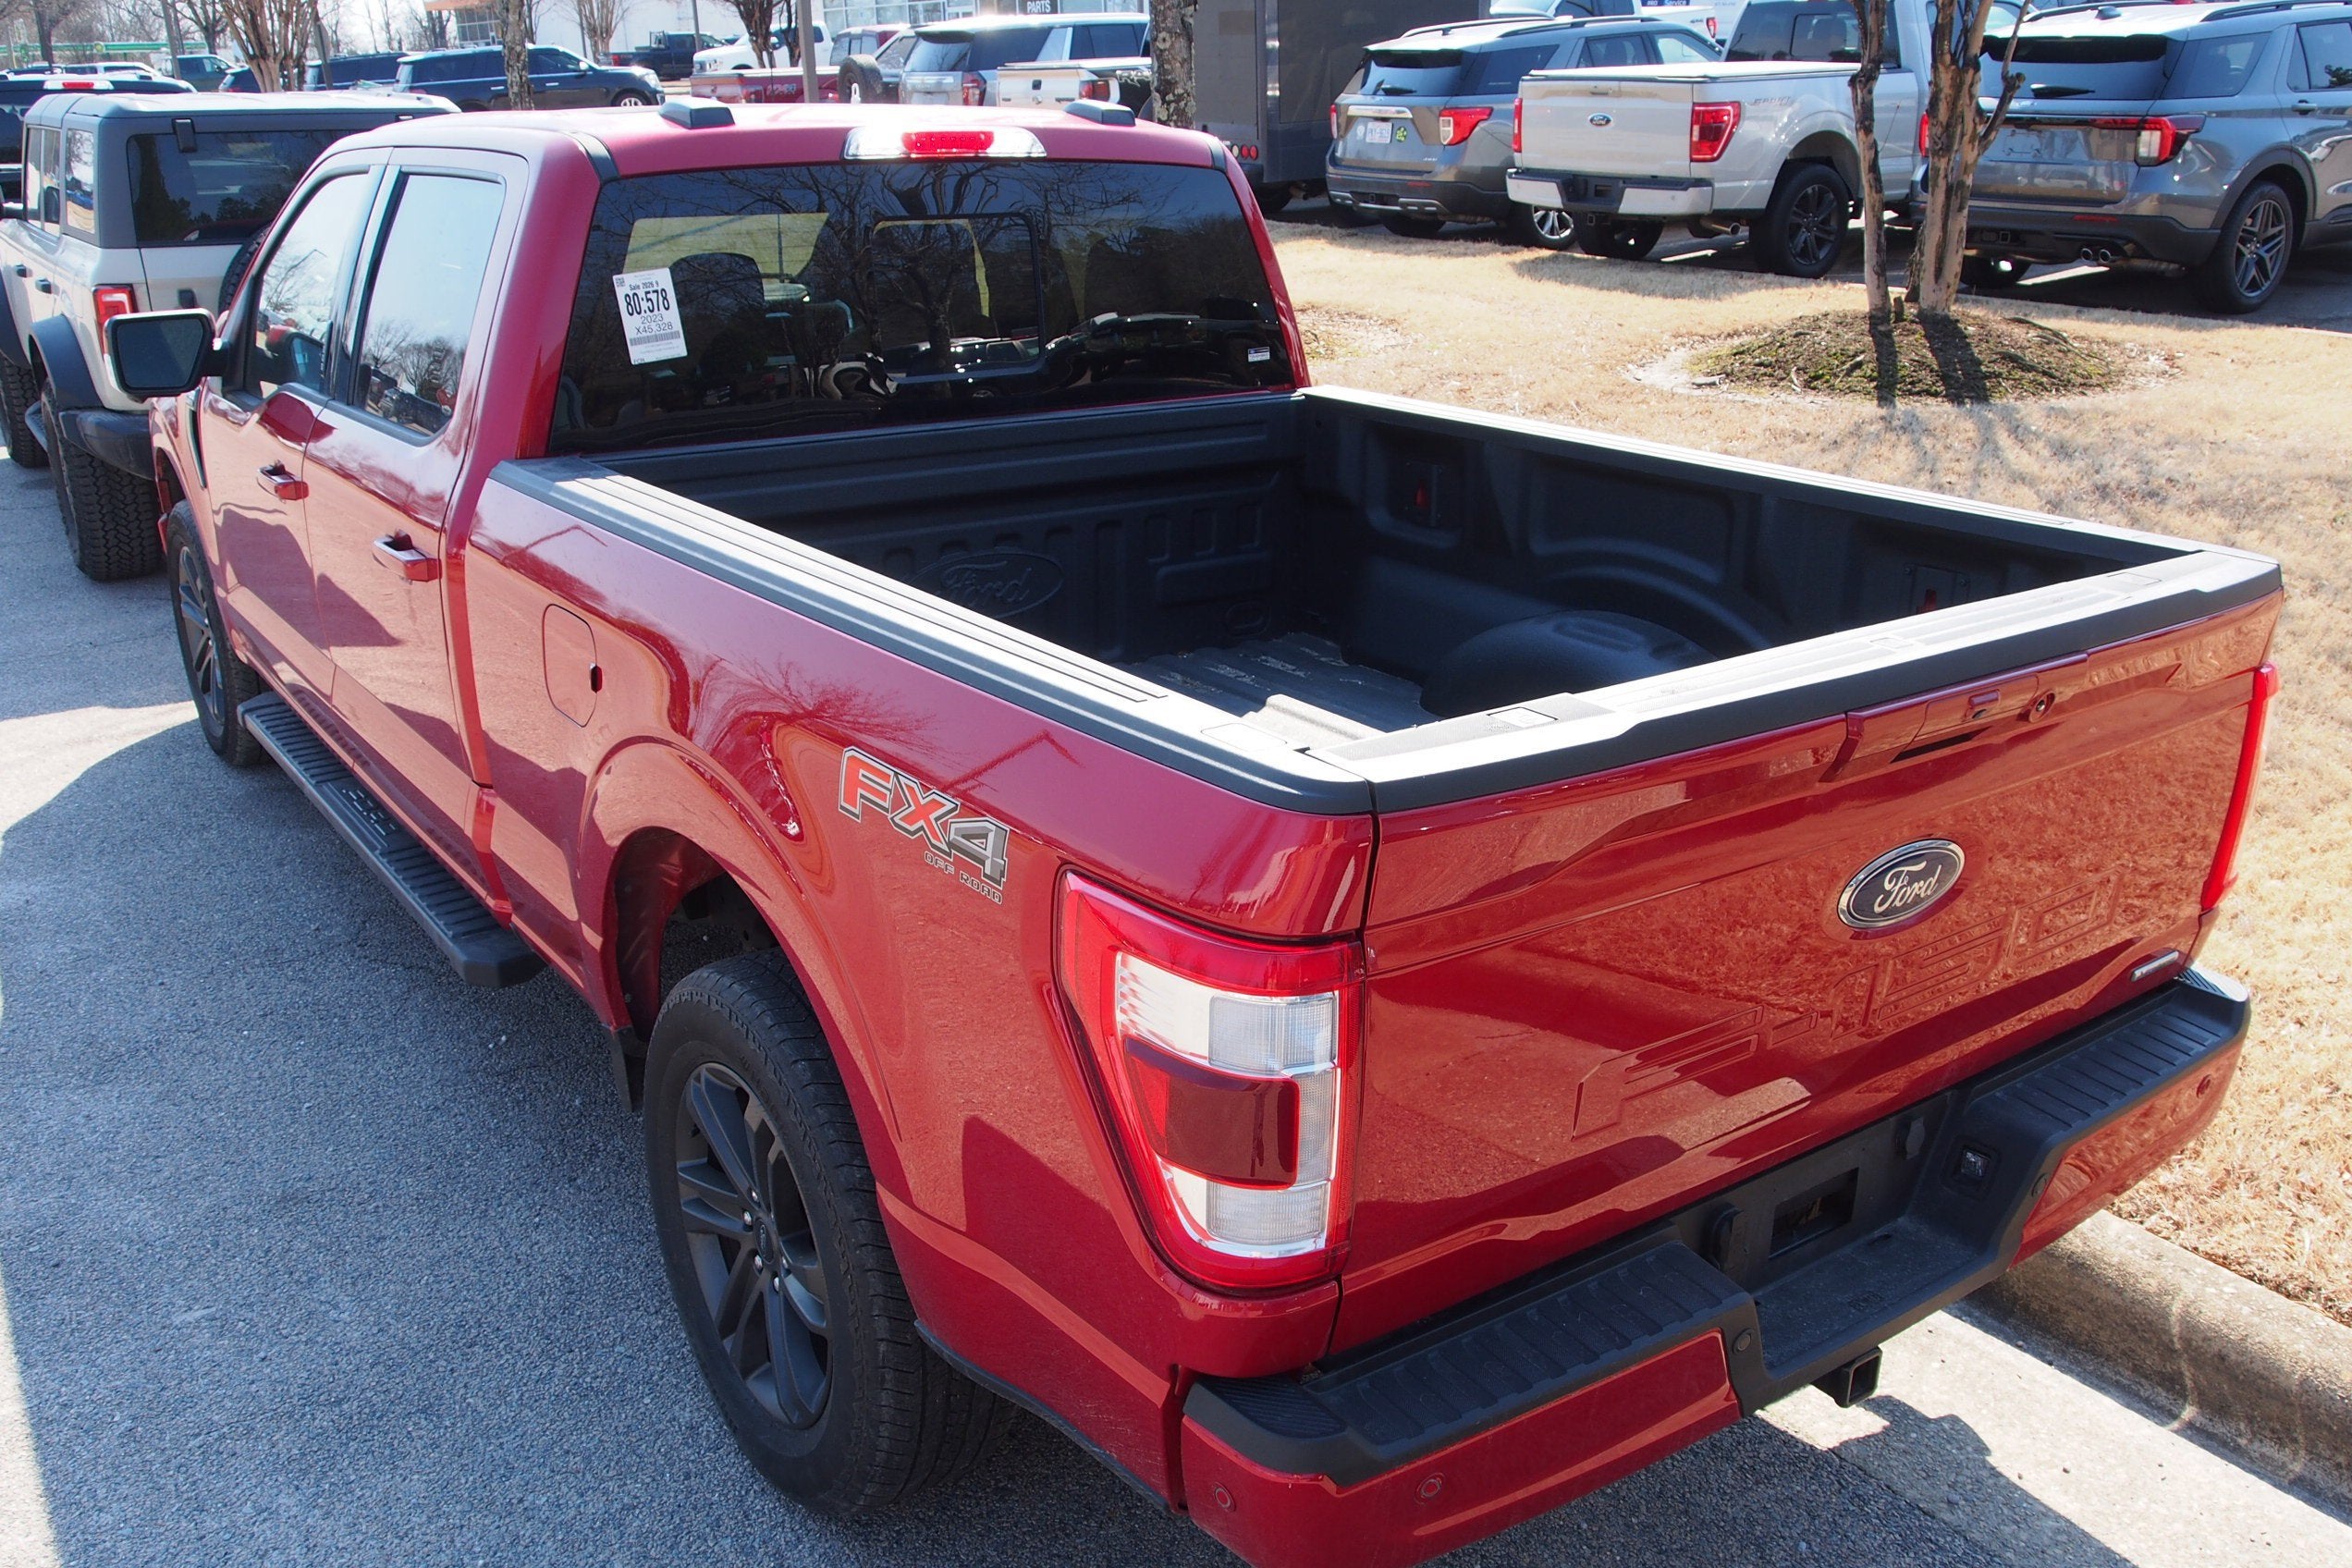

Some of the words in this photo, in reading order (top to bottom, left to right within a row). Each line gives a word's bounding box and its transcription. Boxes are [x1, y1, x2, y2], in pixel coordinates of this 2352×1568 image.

[1027, 0, 1051, 14] PARTS
[624, 288, 670, 317] 80:578
[640, 312, 664, 325] 2023
[838, 745, 1011, 890] FX4
[925, 851, 955, 875] OFF
[960, 870, 1002, 905] ROAD
[1874, 861, 1942, 914] Ford
